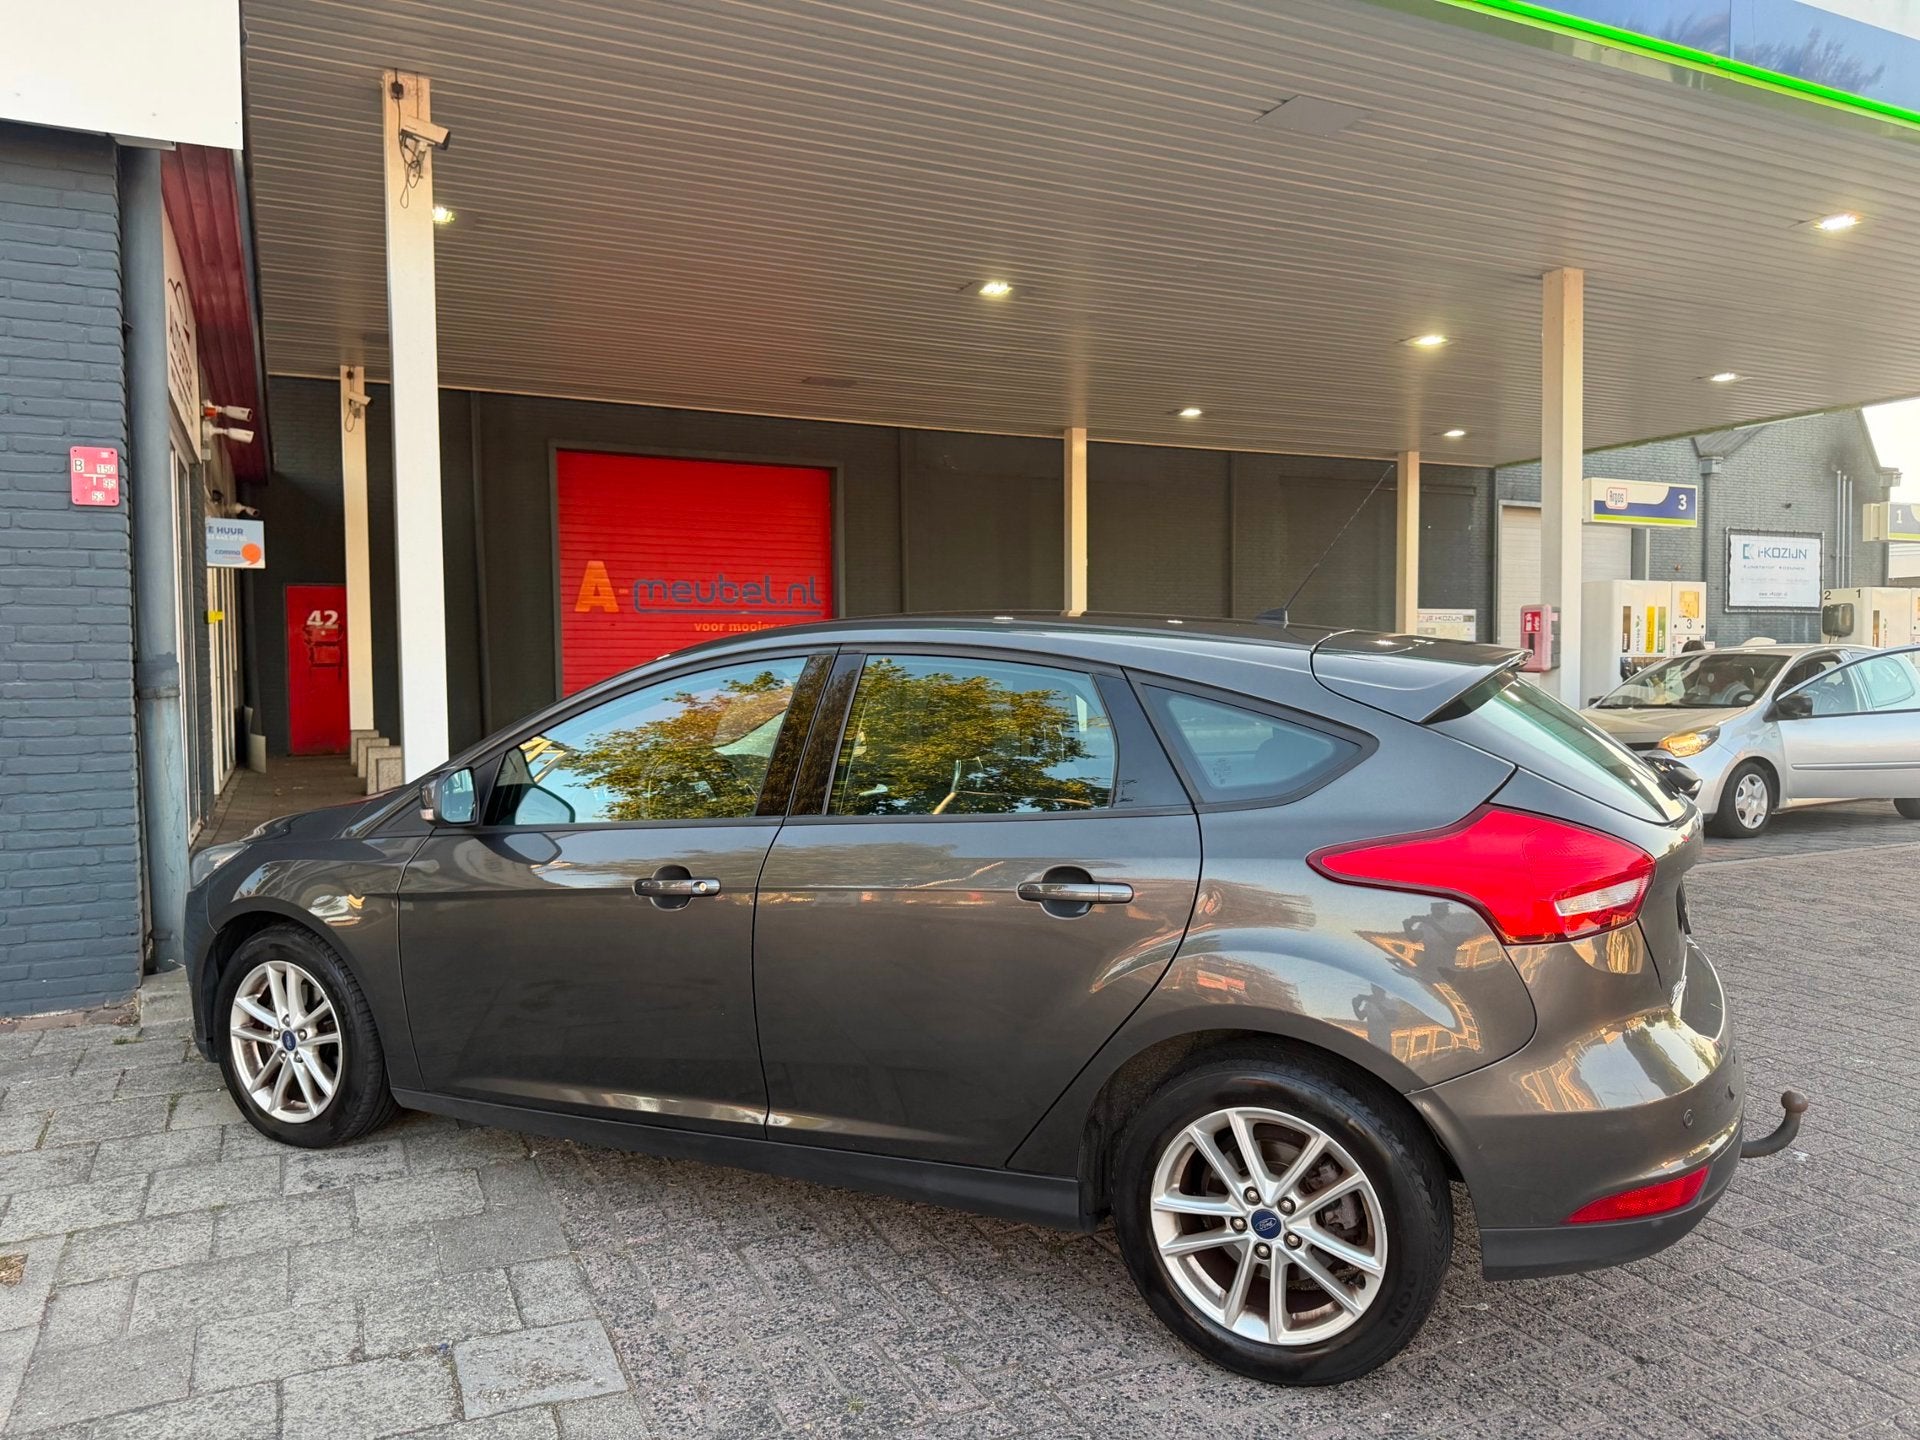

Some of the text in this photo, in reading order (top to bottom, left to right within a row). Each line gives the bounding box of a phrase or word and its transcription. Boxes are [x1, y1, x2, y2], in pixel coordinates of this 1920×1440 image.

[74, 459, 83, 471] B
[1678, 494, 1687, 511] 3
[1896, 509, 1903, 524] 1
[216, 526, 244, 536] HUUR
[1824, 590, 1832, 600] 2
[1855, 588, 1861, 598] 1
[306, 610, 339, 629] 42
[1686, 618, 1692, 629] 3
[694, 623, 725, 632] voor
